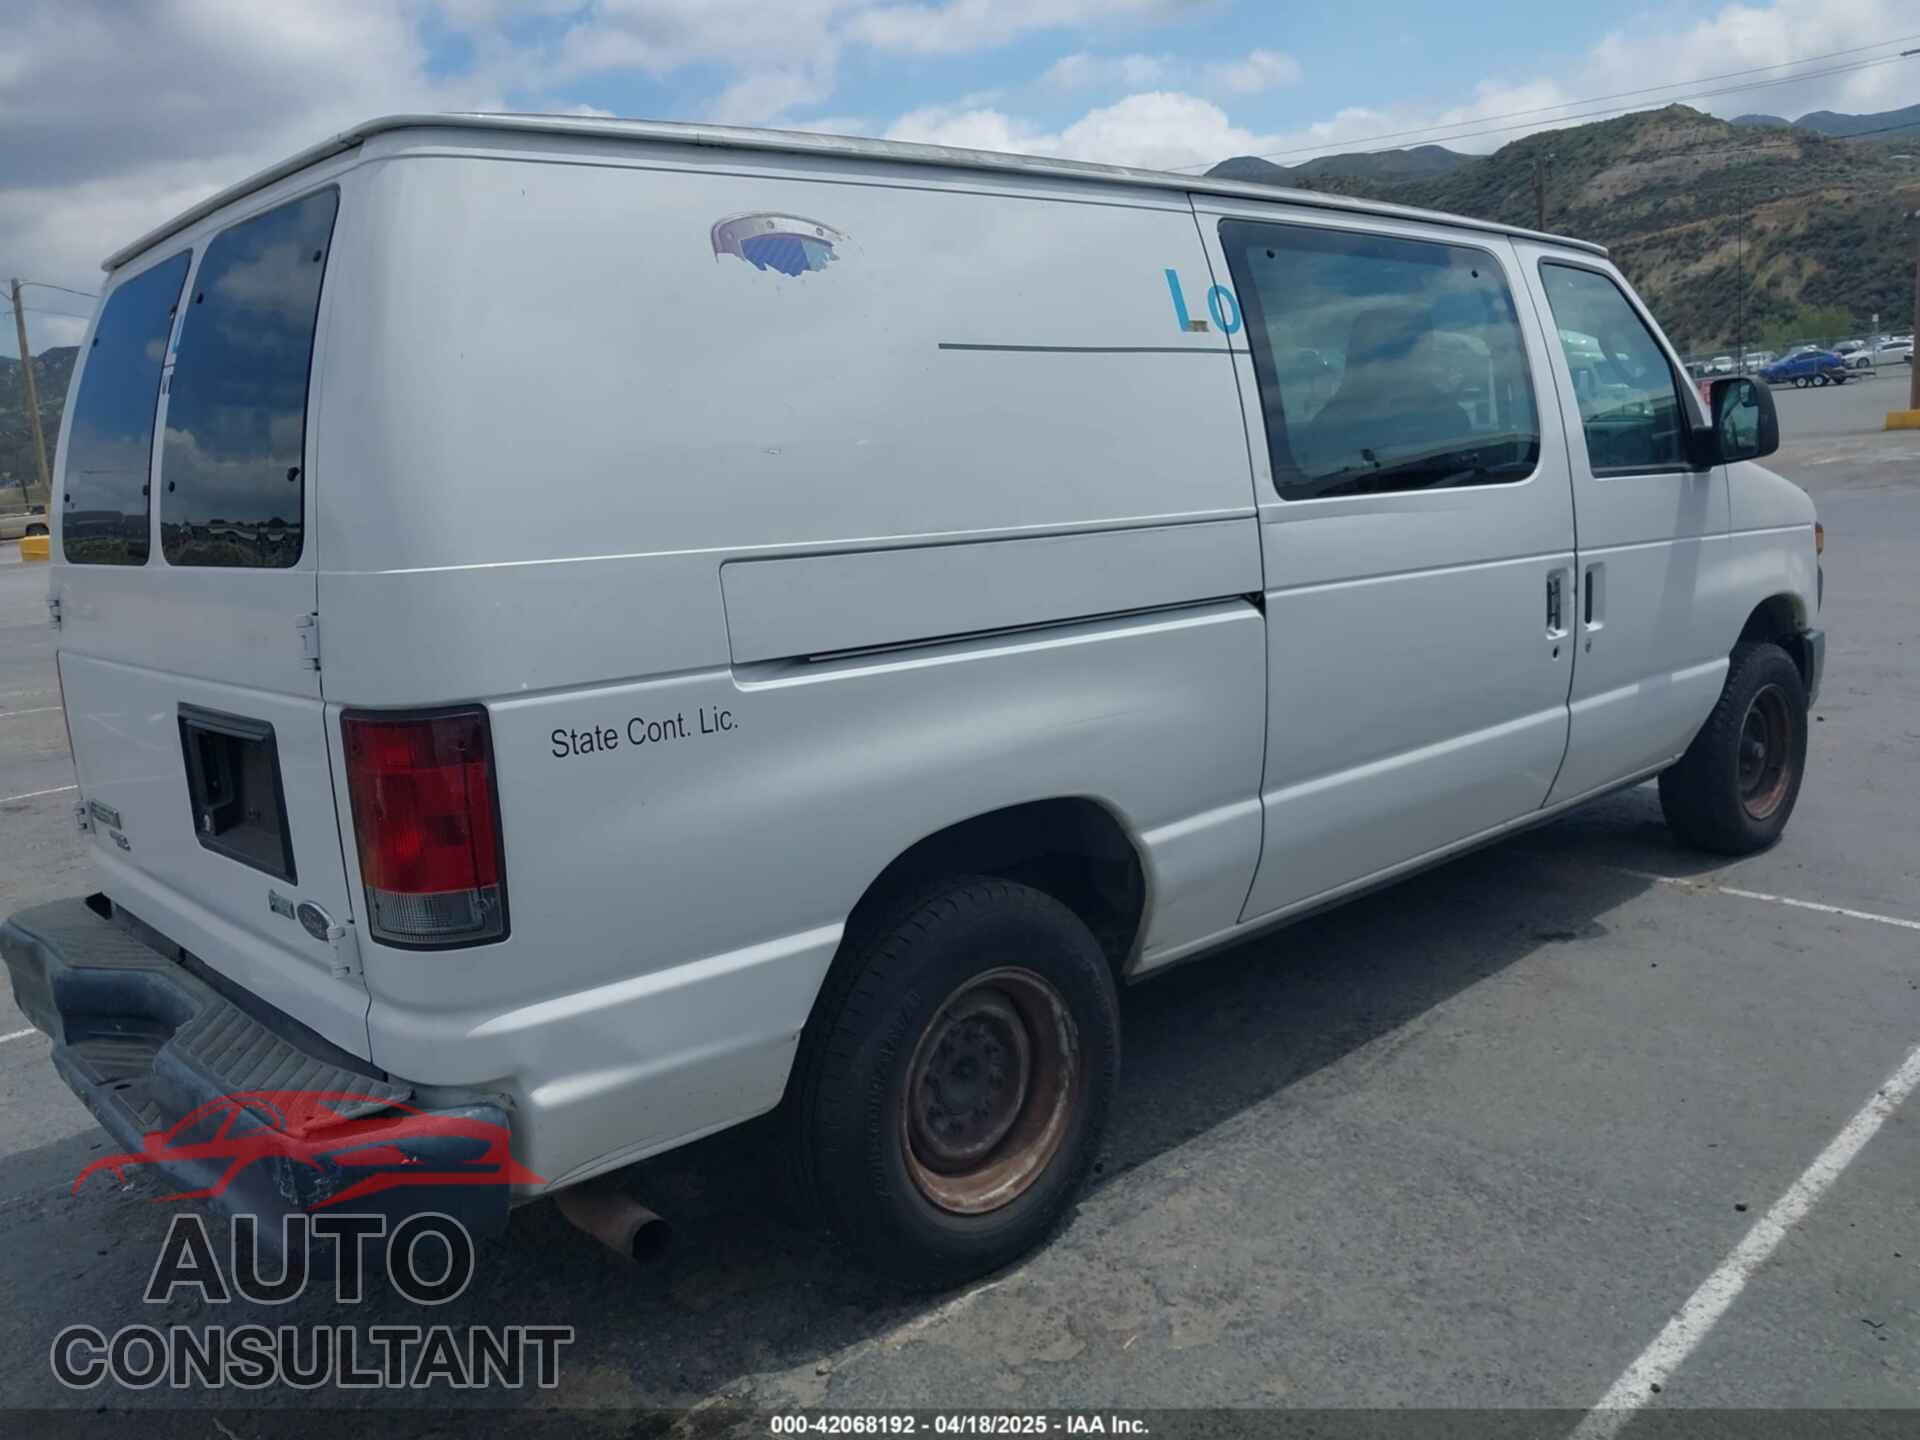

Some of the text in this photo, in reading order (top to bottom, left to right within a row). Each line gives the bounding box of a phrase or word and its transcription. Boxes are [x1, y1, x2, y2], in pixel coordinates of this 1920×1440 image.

[1164, 269, 1241, 334] Lo
[551, 705, 739, 758] State Cont. Lic.
